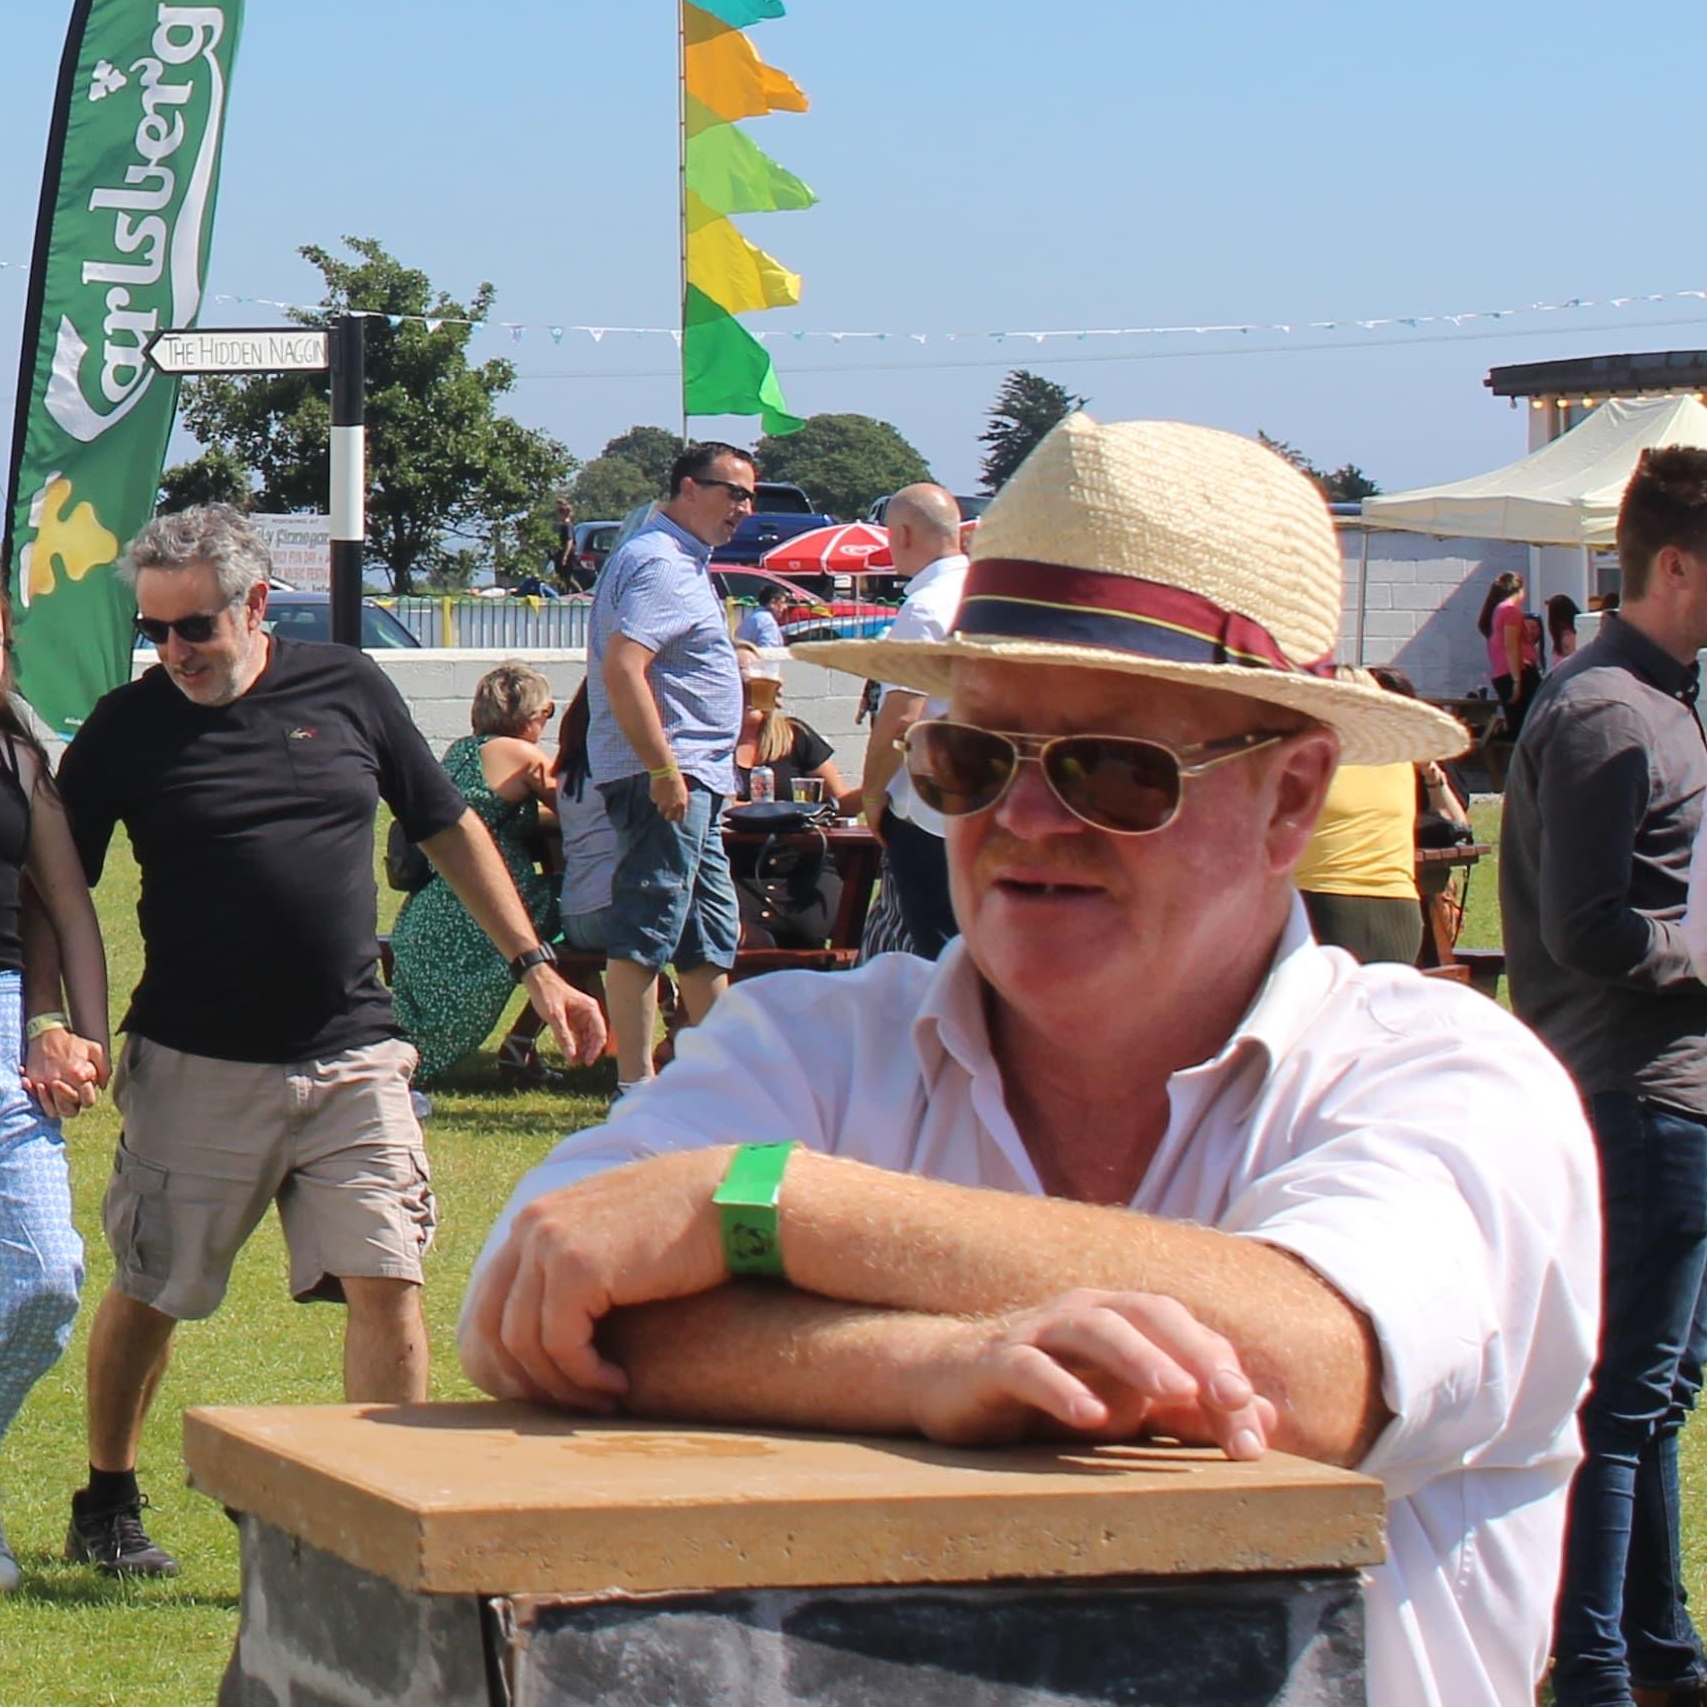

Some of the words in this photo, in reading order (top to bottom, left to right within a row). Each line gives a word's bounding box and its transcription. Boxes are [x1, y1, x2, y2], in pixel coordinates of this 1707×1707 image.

[44, 2, 224, 442] Carlsberg
[163, 336, 194, 365] THE
[200, 337, 262, 366] HIDDEN
[270, 336, 327, 364] NAGGIN
